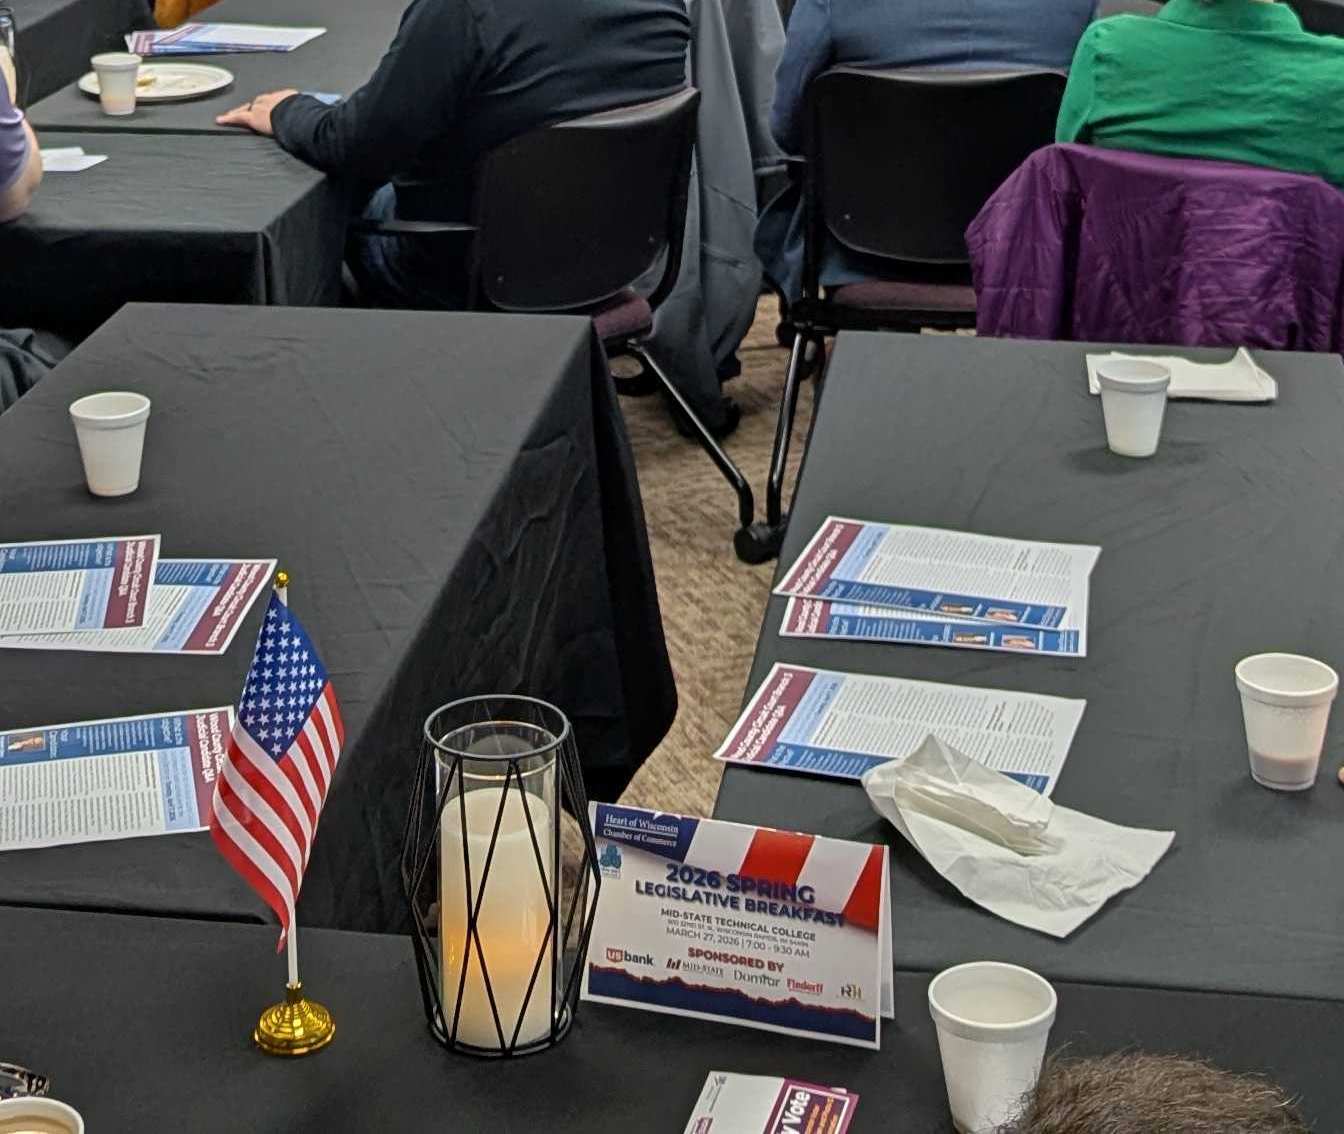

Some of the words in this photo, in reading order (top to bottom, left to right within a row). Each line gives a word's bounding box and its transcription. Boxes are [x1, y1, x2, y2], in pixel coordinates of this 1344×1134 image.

[605, 813, 628, 826] Heart
[628, 817, 636, 827] of
[639, 818, 679, 834] Wisconsin
[633, 832, 641, 842] of
[664, 862, 722, 890] 2026
[725, 872, 816, 905] SPRING
[634, 879, 740, 911] LEGISLATIVE
[744, 897, 846, 928] BREAKFAST
[660, 907, 712, 924] MID-STATE
[715, 916, 769, 934] TECHNICAL
[771, 925, 816, 941] COLLEGE
[624, 950, 653, 966] bank
[666, 926, 700, 940] MARCH
[702, 932, 716, 943] 27,
[717, 934, 739, 946] 2026
[793, 948, 809, 958] AM
[687, 946, 764, 969] SPONSORED
[767, 960, 784, 973] BY
[782, 1088, 812, 1128] Vote
